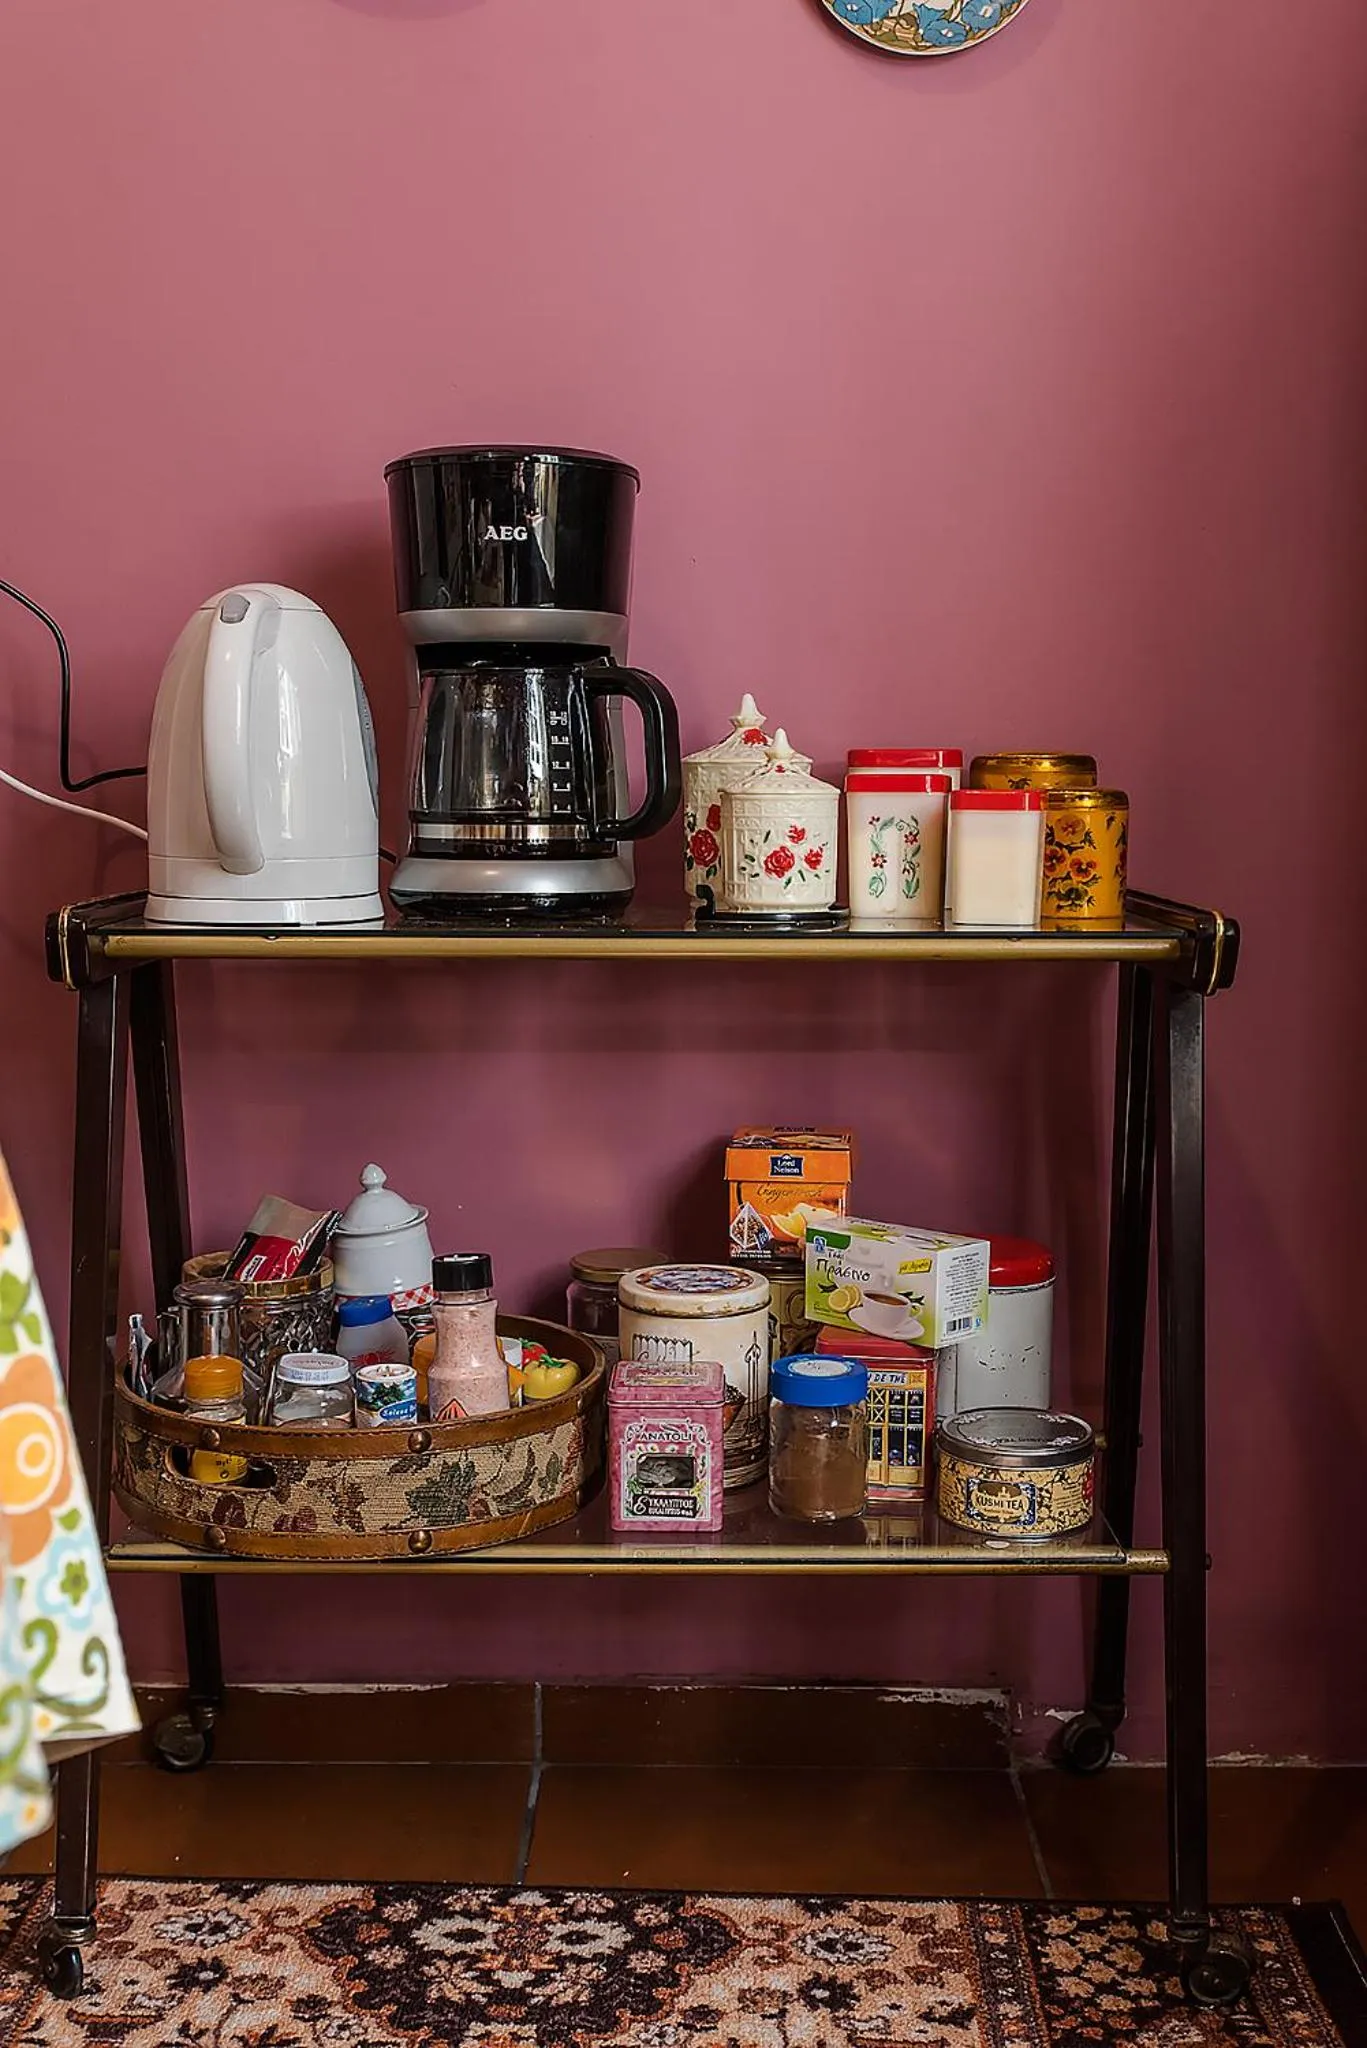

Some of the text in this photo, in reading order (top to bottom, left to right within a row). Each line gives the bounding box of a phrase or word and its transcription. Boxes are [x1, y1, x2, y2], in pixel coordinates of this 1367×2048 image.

[483, 525, 528, 541] AEG
[773, 1166, 800, 1174] Nelson
[874, 1373, 886, 1383] DE
[639, 1432, 692, 1442] ANATOLI
[1006, 1499, 1024, 1511] TEA
